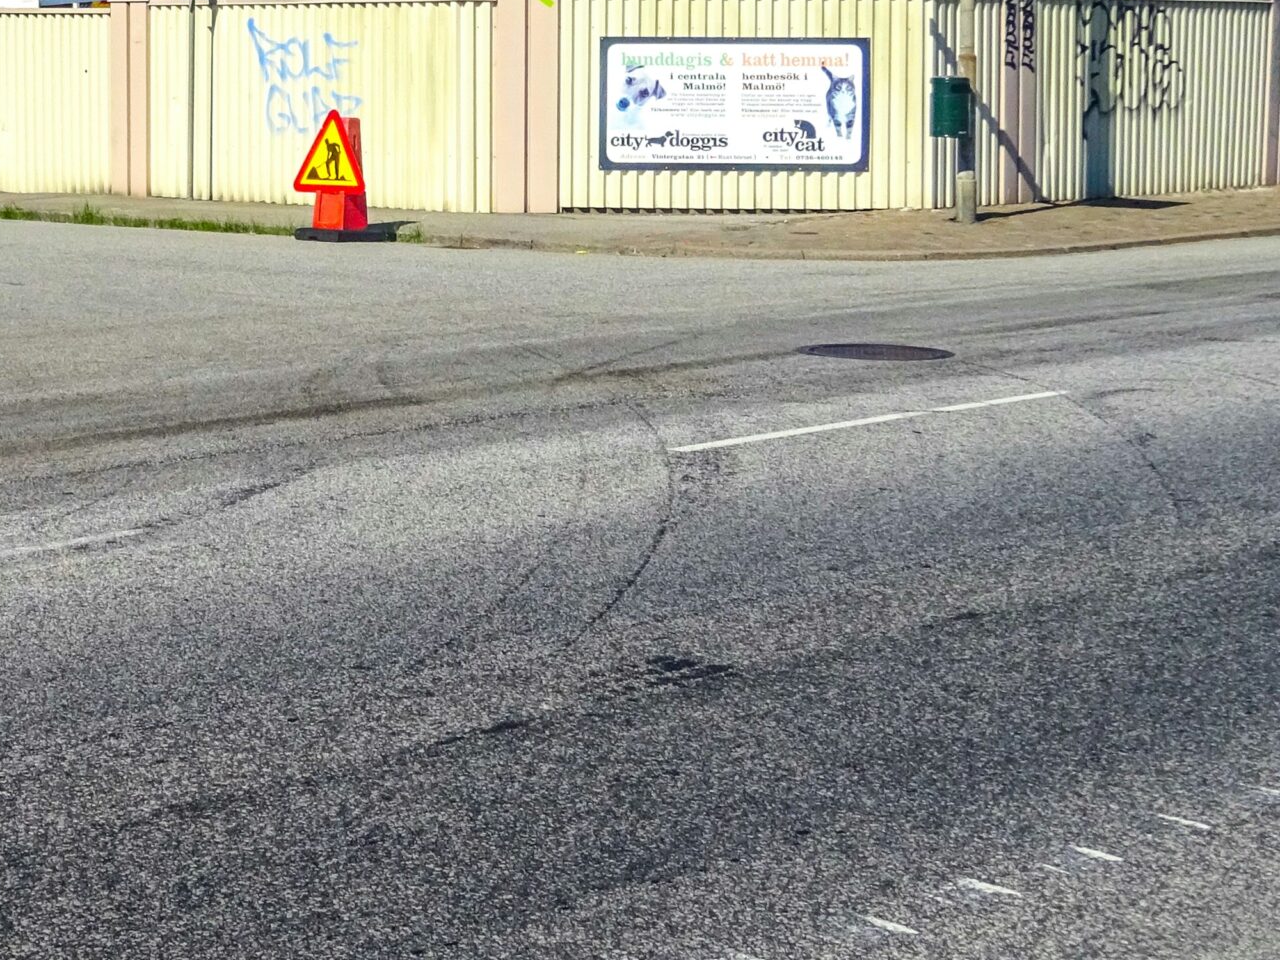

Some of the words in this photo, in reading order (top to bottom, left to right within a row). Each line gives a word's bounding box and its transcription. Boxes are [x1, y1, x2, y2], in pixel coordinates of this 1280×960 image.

[621, 52, 712, 71] hunddagis
[719, 52, 735, 67] &
[741, 52, 777, 67] katt
[780, 52, 849, 67] hemma!
[677, 72, 727, 80] centrala
[742, 72, 800, 81] hembesök
[682, 82, 727, 91] Malmö!
[742, 82, 786, 91] Malmö!
[610, 132, 645, 151] city
[669, 129, 729, 152] doggis
[762, 127, 799, 147] city
[794, 136, 826, 152] cat
